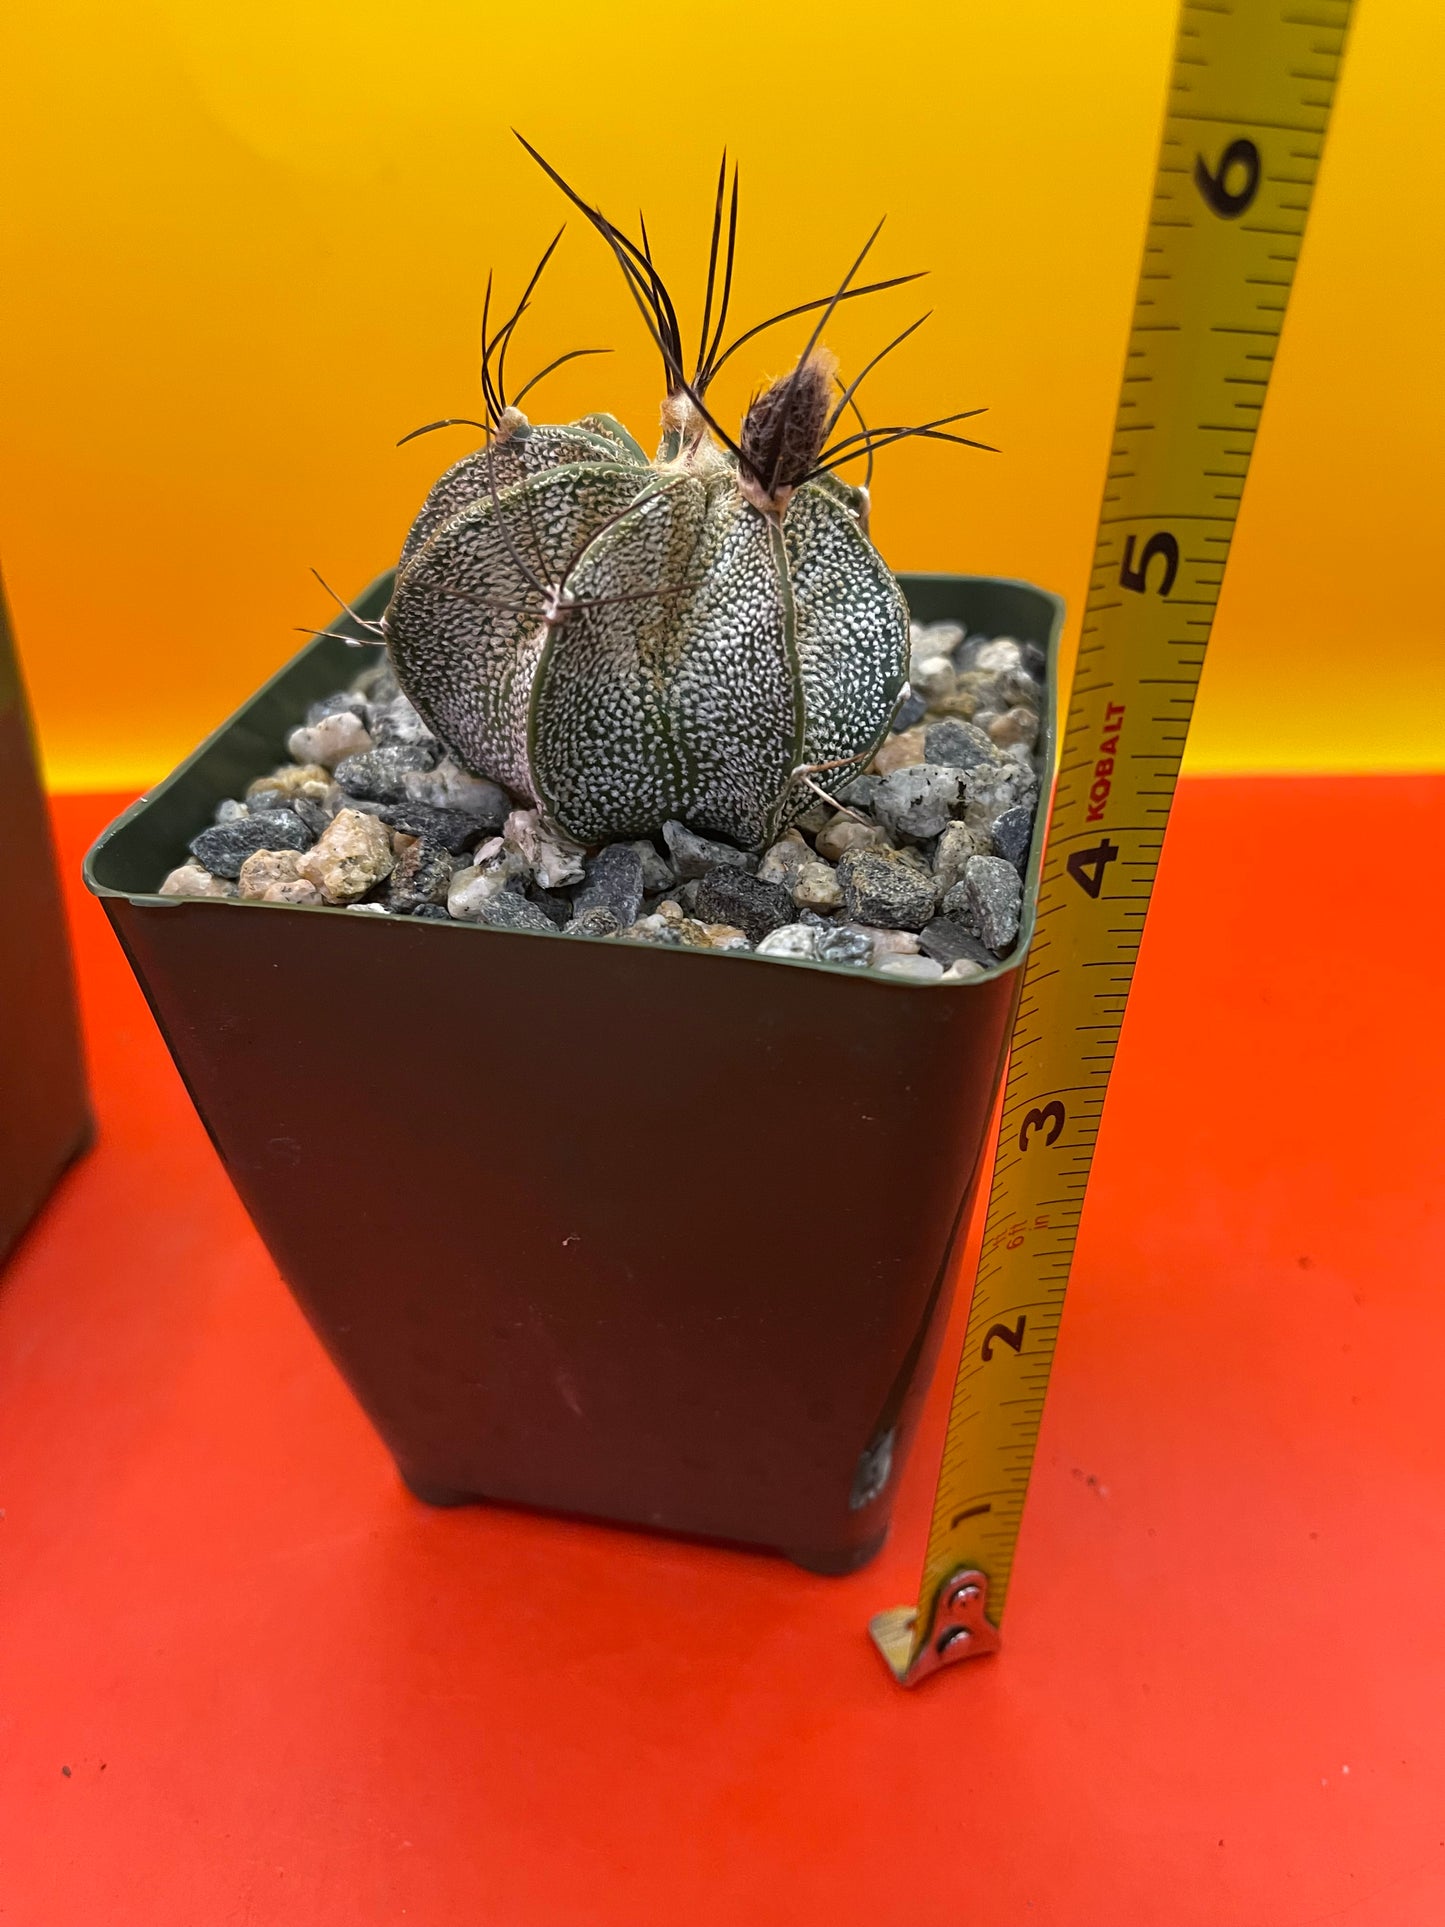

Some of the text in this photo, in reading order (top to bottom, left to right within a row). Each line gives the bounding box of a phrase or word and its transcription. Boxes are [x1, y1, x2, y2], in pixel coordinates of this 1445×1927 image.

[1194, 138, 1261, 220] 6
[1119, 531, 1179, 597] 5
[1086, 701, 1126, 823] KOBALT
[1066, 838, 1119, 899] 4
[1019, 1100, 1065, 1152] 3
[981, 1315, 1027, 1362] 2
[950, 1503, 992, 1531] 1
